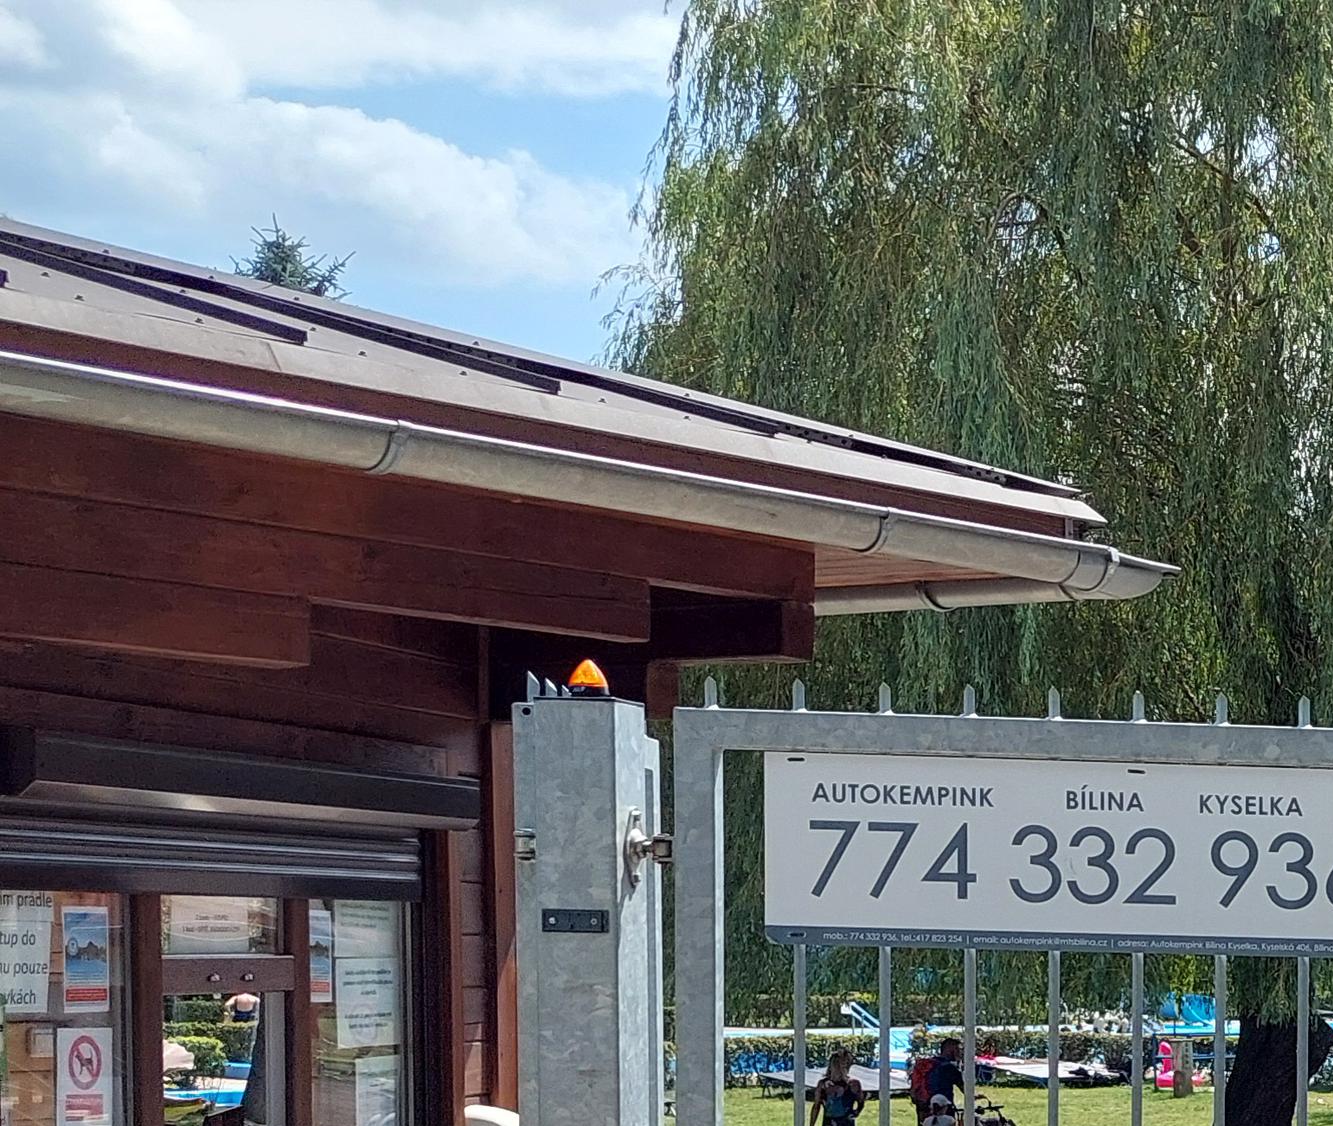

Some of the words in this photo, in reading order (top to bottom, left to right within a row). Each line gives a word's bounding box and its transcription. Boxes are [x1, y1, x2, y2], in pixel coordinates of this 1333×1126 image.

[811, 782, 995, 809] AUTOKEMPINK
[1065, 783, 1145, 813] BÍLINA
[1198, 792, 1303, 817] KYSELKA
[809, 820, 977, 900] 774
[1009, 824, 1177, 906] 332
[21, 930, 36, 946] do
[13, 962, 49, 978] pouze
